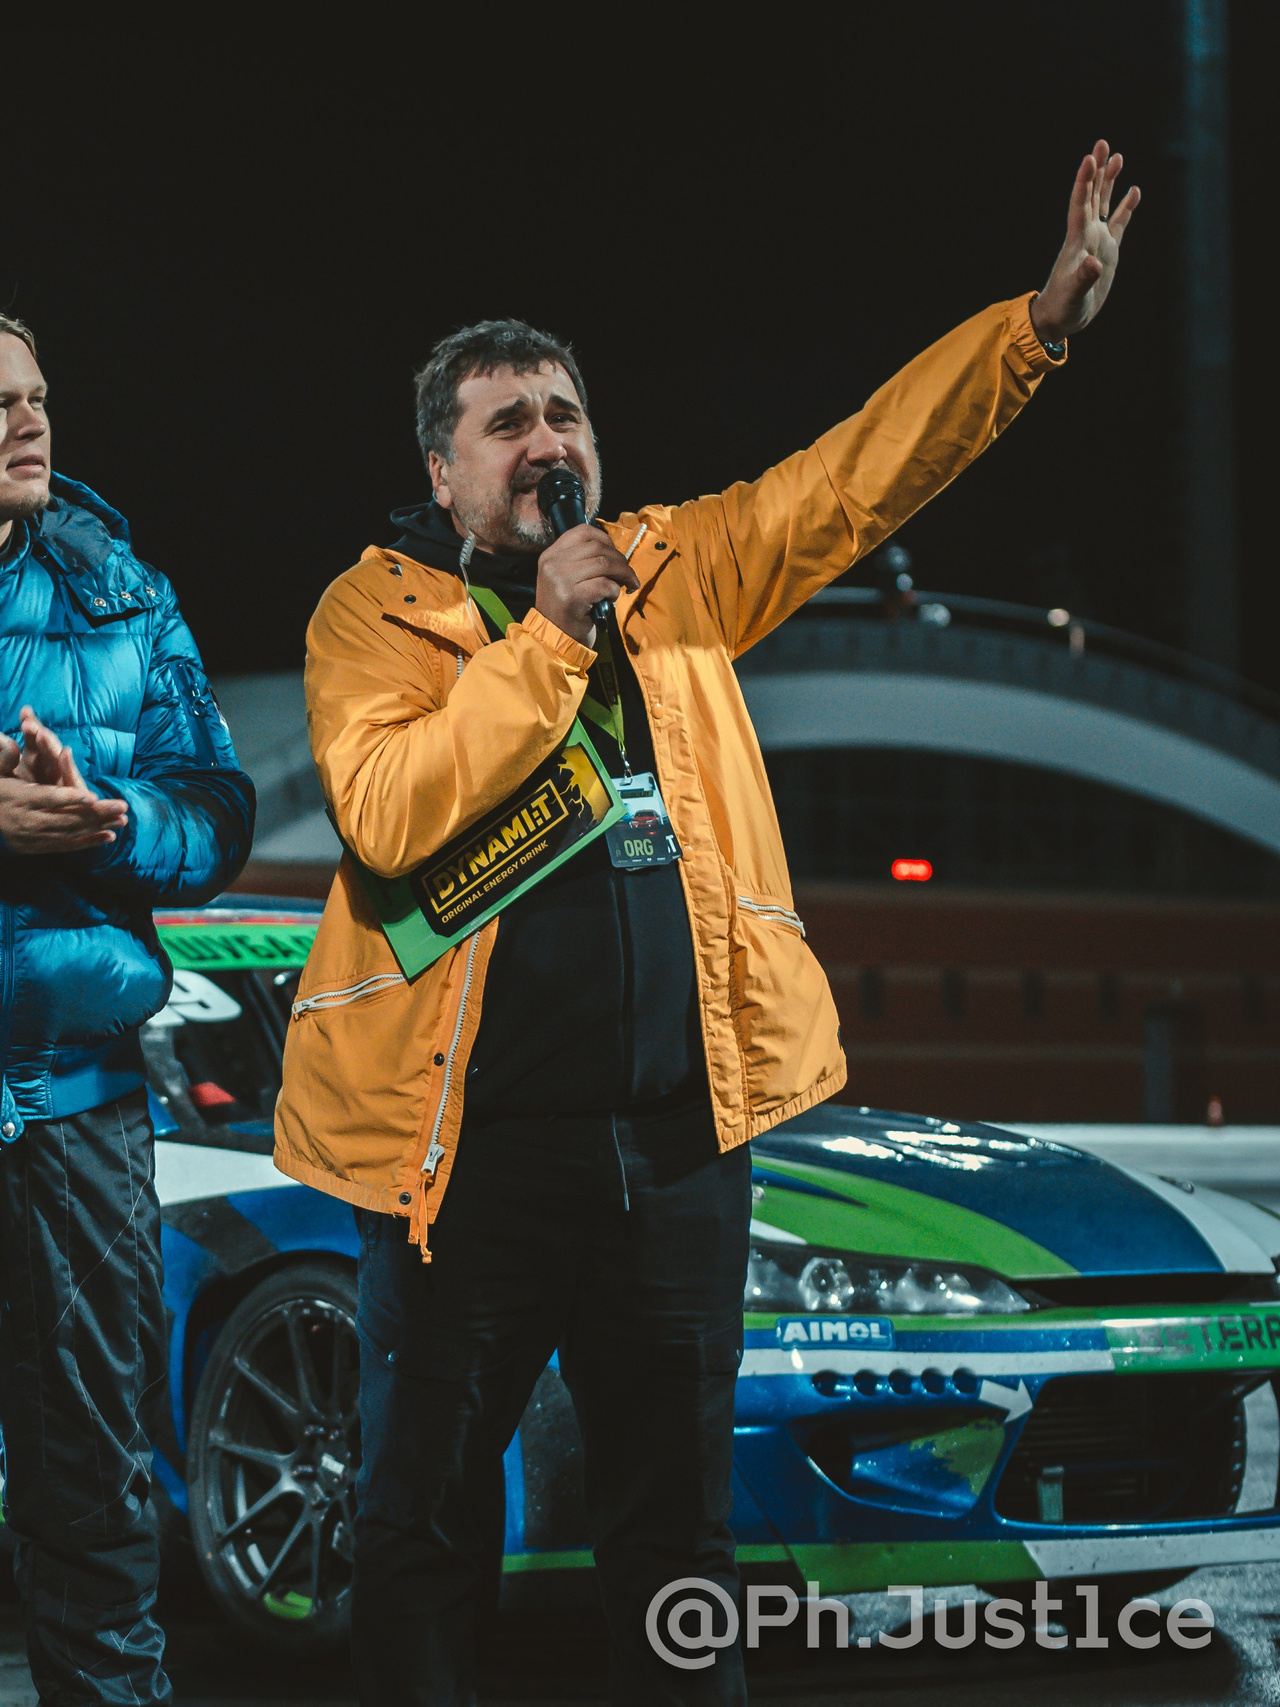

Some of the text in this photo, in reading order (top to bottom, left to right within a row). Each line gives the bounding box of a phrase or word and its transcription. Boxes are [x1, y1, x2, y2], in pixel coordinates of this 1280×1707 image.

[623, 838, 654, 857] ORG
[441, 889, 484, 924] ORIGINAL
[483, 861, 519, 893] ENERGY
[519, 840, 549, 865] DRINK
[783, 1321, 888, 1343] AIMOL
